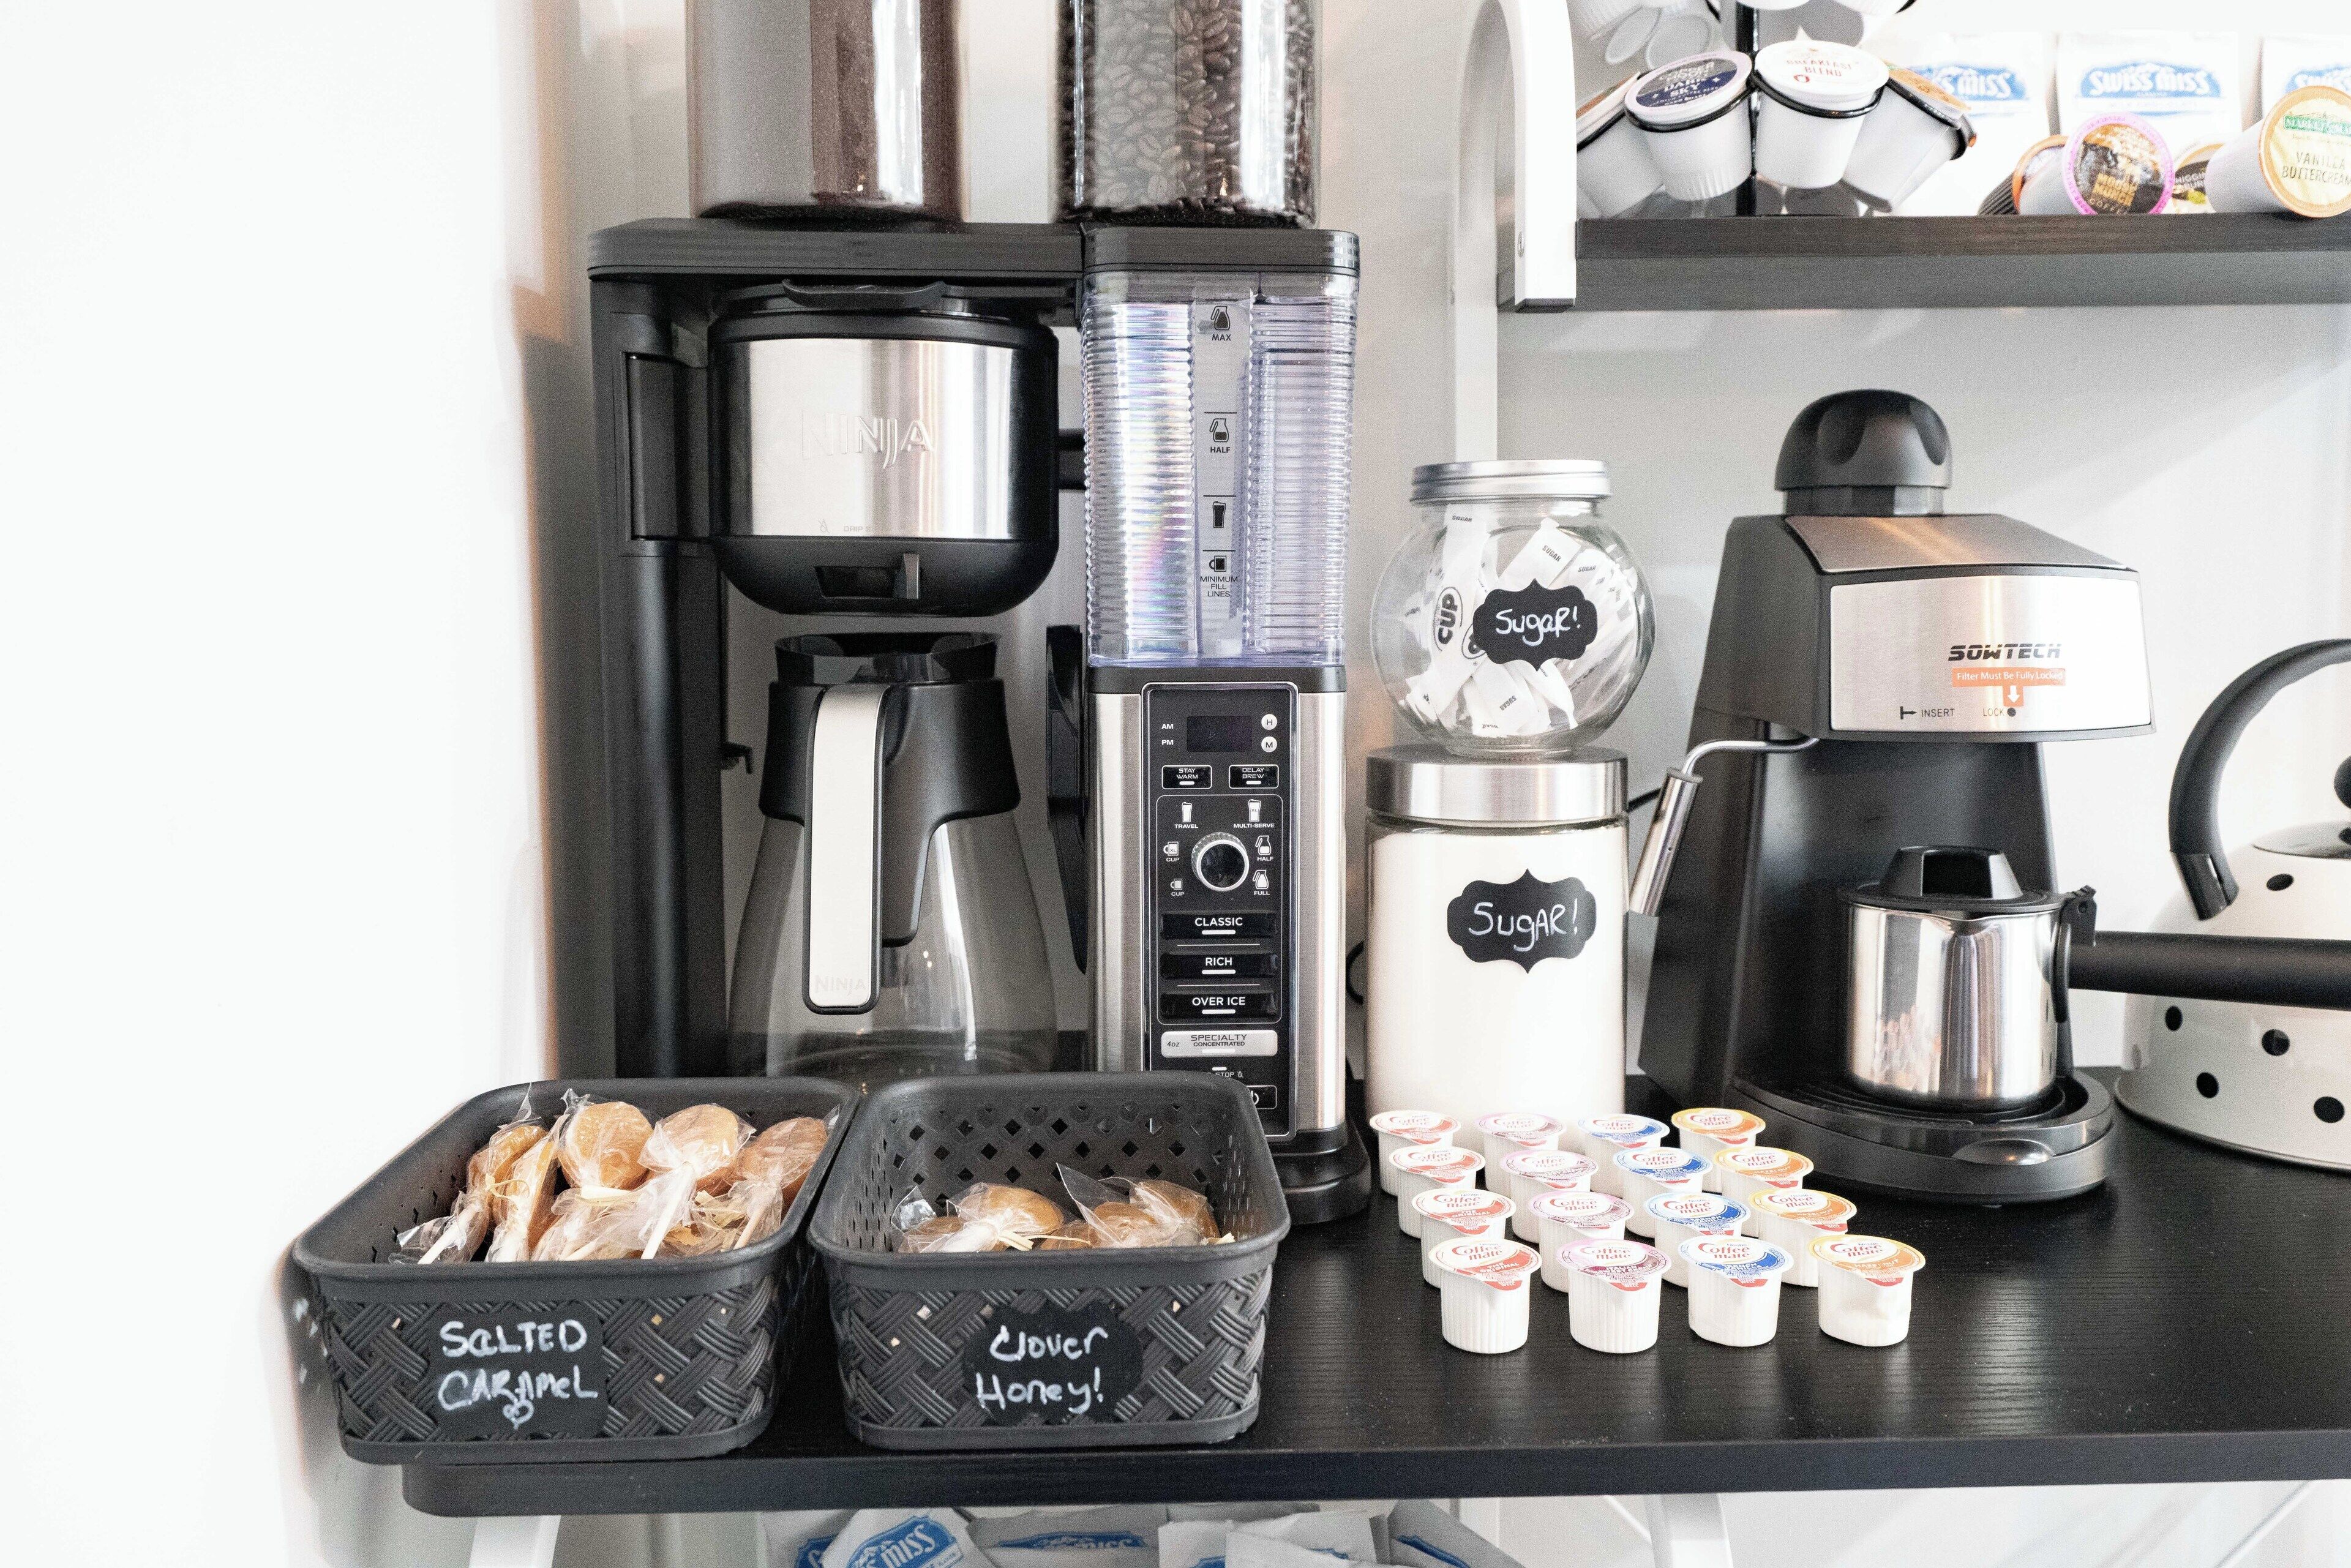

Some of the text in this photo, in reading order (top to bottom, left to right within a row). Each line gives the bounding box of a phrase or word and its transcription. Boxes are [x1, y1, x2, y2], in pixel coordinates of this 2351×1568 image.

[1804, 66, 1842, 77] BLEND
[1670, 83, 1701, 97] SKY
[2297, 151, 2345, 170] VANILLA
[802, 410, 934, 470] NINJA
[1542, 544, 1562, 563] SUGAR
[1438, 593, 1458, 645] CUP
[1948, 643, 2061, 661] SOWTECH
[1957, 670, 2063, 681] Filter Must Be Fully Locked
[1921, 708, 2004, 718] INSERT LOCK
[1194, 917, 1243, 926] CLASSIC
[1205, 957, 1232, 966] RICH
[1192, 996, 1246, 1006] OVER ICE
[1663, 1200, 1711, 1210] Coffee
[1768, 1195, 1814, 1204] Coffee
[1452, 1245, 1502, 1256] Coffee
[1698, 1242, 1750, 1254] Coffee
[1830, 1243, 1882, 1253] Coffee
[976, 1366, 1104, 1416] Honey!
